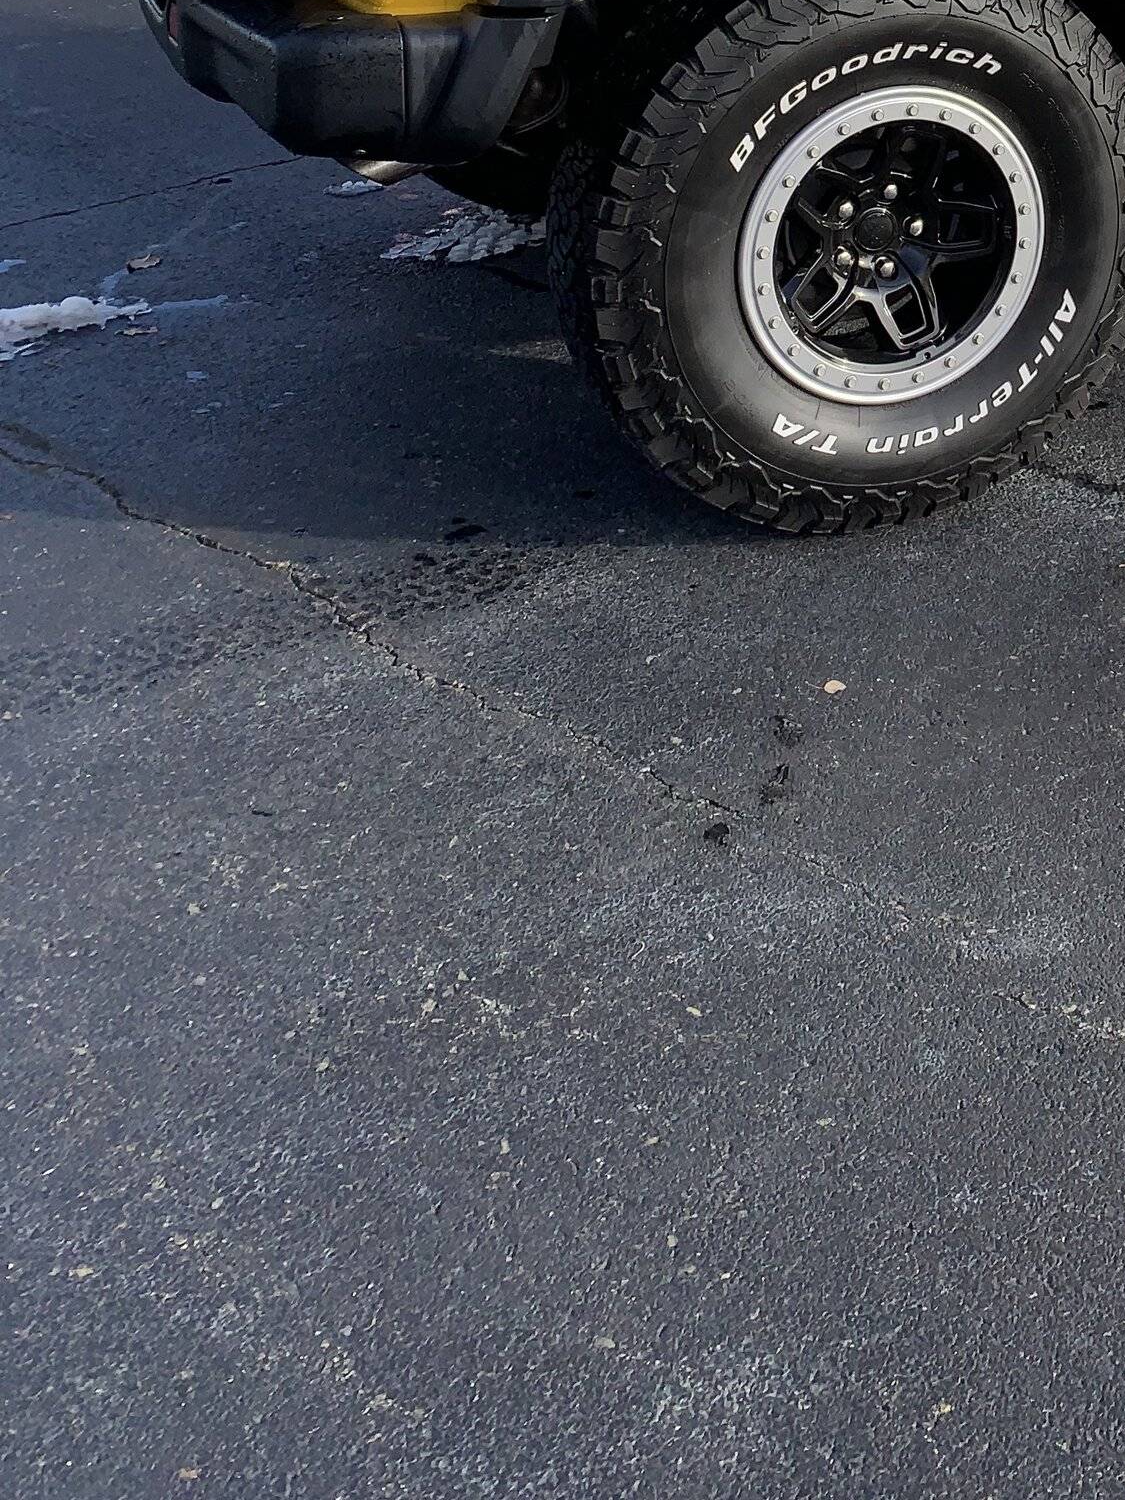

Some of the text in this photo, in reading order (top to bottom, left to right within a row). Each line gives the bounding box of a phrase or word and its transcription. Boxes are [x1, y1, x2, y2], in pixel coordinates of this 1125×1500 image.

[728, 41, 1003, 174] BFGoodrich
[771, 412, 840, 456] T/A
[866, 288, 1078, 455] All-Terrain
